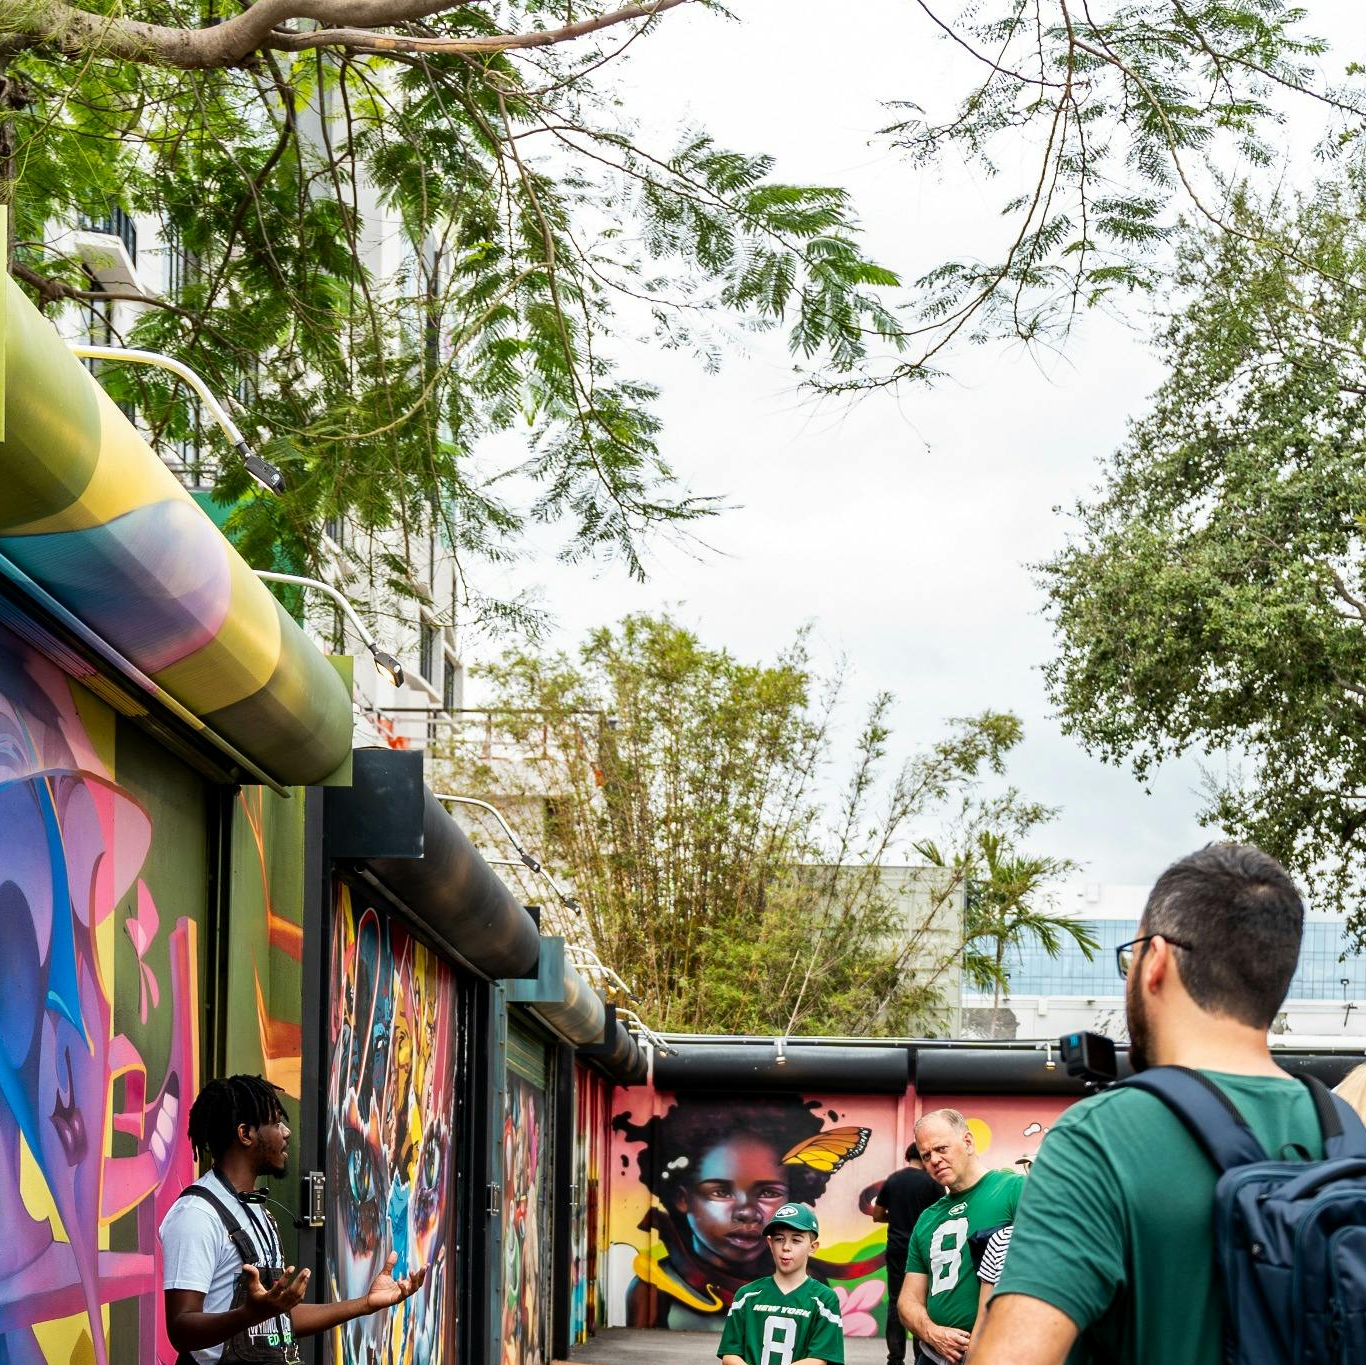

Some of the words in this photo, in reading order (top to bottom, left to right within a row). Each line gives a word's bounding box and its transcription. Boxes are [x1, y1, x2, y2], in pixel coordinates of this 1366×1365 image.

[930, 1217, 969, 1296] 8
[753, 1304, 781, 1312] NEW
[780, 1306, 811, 1318] YORK
